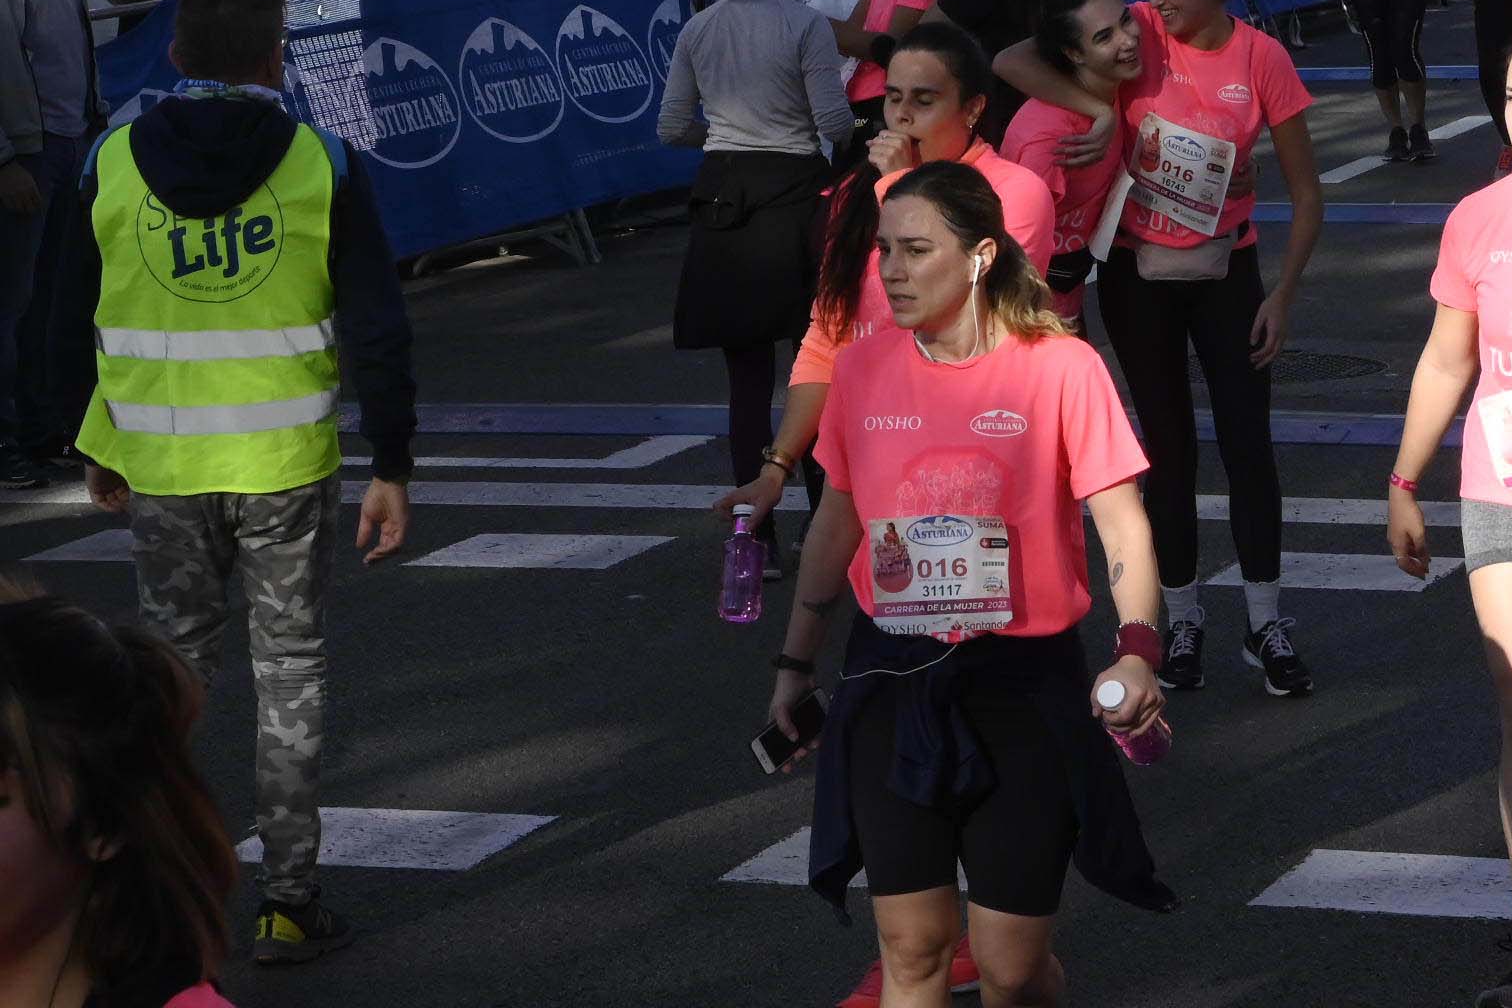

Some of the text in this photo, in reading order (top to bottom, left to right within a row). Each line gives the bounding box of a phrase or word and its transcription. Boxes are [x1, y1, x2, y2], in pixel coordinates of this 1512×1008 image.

[565, 53, 649, 98] ASTURIANA
[469, 69, 562, 116] ASTURIANA
[1162, 160, 1194, 182] 016
[1162, 176, 1186, 192] 16743
[167, 207, 276, 280] Life
[864, 416, 922, 431] OYSHO
[975, 419, 1023, 431] ASTURIANA
[977, 521, 1004, 529] SUMA
[912, 526, 969, 540] ASTURIANA
[917, 558, 968, 578] 016
[922, 584, 962, 597] 31117
[884, 600, 1008, 614] CARRERA DE LA MUJER 2023
